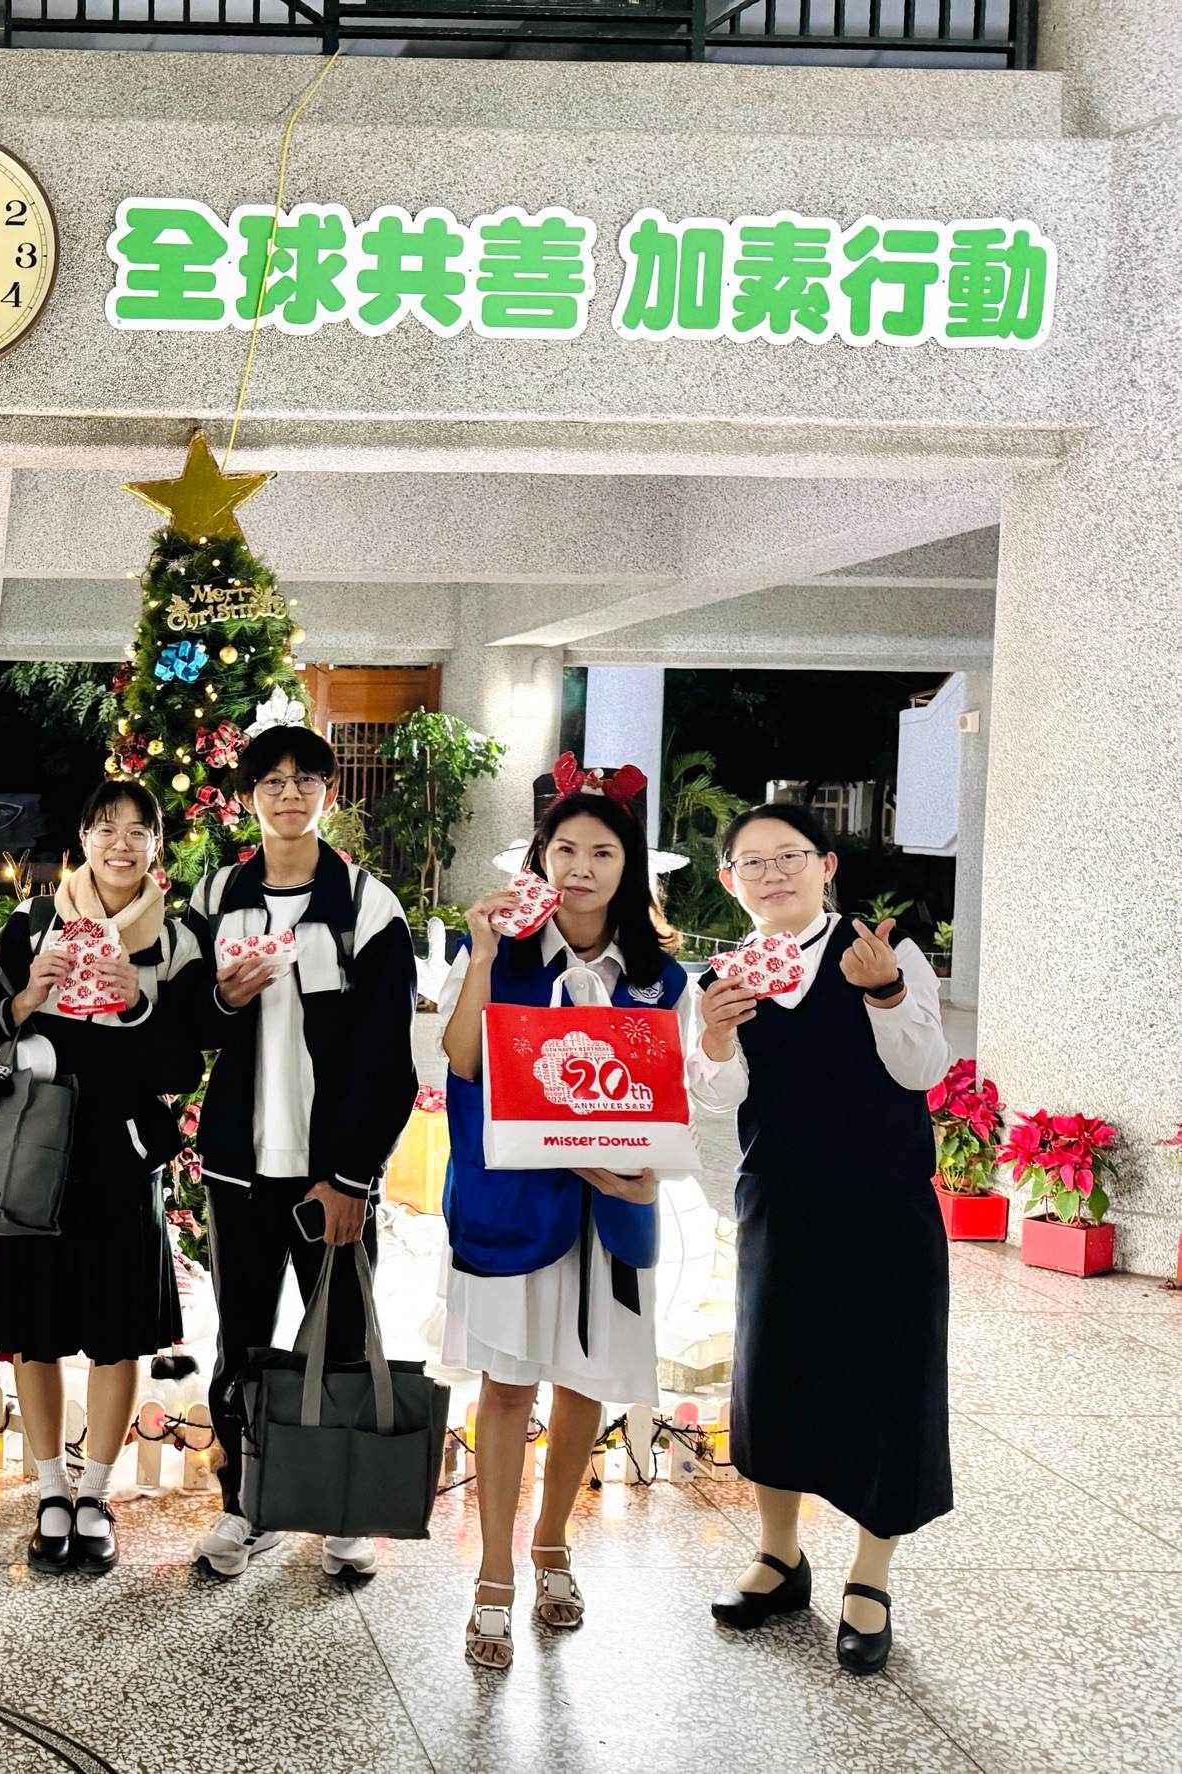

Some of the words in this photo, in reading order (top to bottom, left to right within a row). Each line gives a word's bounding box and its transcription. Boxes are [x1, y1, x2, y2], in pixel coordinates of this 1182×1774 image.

[4, 200, 28, 226] 2
[15, 242, 37, 268] 3
[115, 208, 586, 328] 全球共善
[624, 220, 1047, 340] 加素行動
[0, 281, 22, 308] 4
[188, 583, 265, 604] Merry
[565, 1058, 652, 1101] 20th
[574, 1102, 653, 1110] ANNIVERSARY
[598, 1136, 651, 1147] Donut
